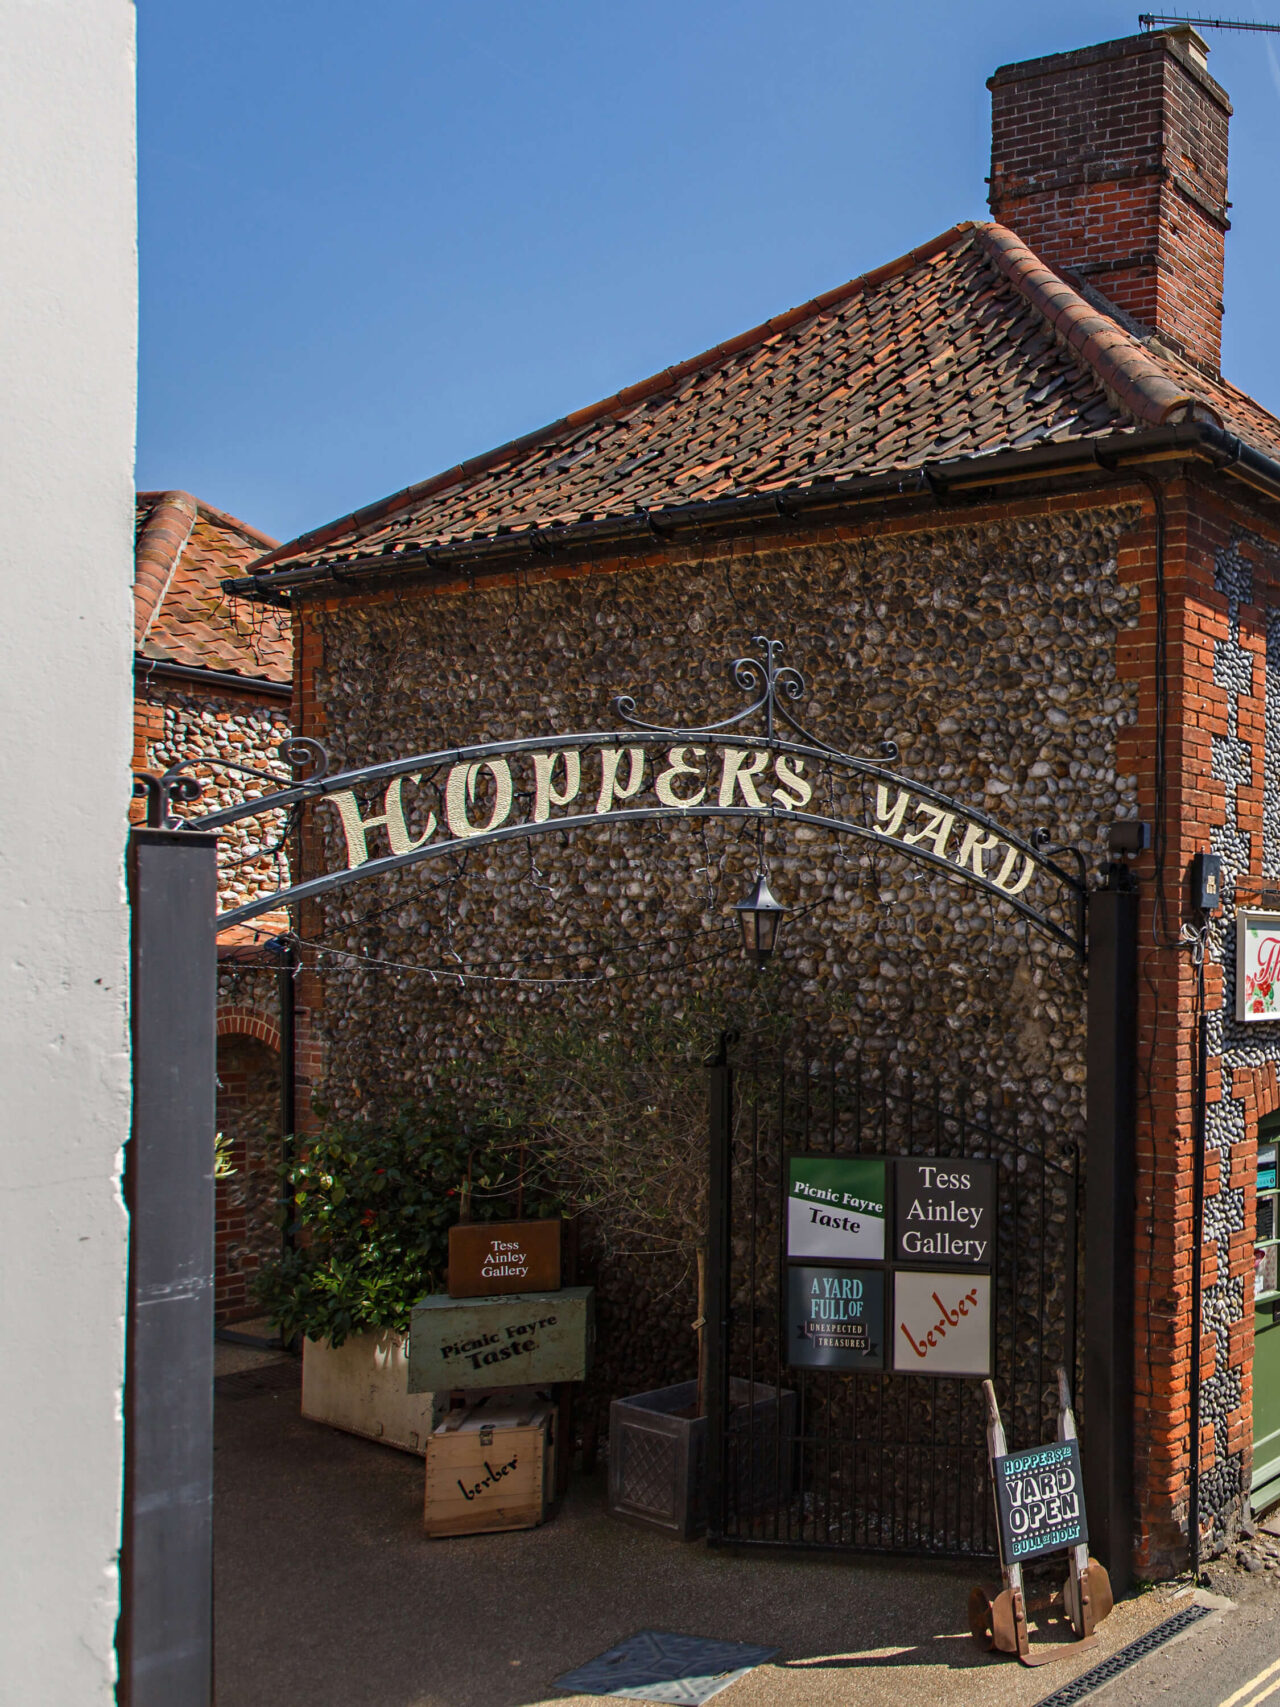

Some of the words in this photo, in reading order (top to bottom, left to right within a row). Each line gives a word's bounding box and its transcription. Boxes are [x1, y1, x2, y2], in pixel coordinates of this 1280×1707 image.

[320, 747, 813, 870] HOPPERS
[873, 782, 1036, 898] YARD
[918, 1166, 971, 1189] Tess
[793, 1181, 840, 1203] Picnic
[842, 1192, 884, 1213] Fayre
[809, 1207, 861, 1234] Taste
[906, 1199, 984, 1229] Ainley
[484, 1252, 527, 1264] Ainley
[490, 1240, 520, 1252] Tess
[902, 1231, 988, 1262] Gallery
[481, 1265, 529, 1278] Gallery
[810, 1277, 821, 1295] A
[823, 1277, 863, 1299] YARD
[811, 1298, 848, 1320] FULL
[848, 1300, 864, 1317] OF
[900, 1288, 978, 1358] berber
[440, 1333, 500, 1359] Picnic
[505, 1315, 558, 1339] Fayre
[810, 1323, 863, 1334] UNEXPECTED
[818, 1337, 866, 1348] TREASURES
[465, 1339, 536, 1370] Taste
[457, 1453, 520, 1501] berber
[1005, 1449, 1064, 1475] HOPPERS
[1006, 1467, 1076, 1507] YARD
[1009, 1492, 1080, 1534] OPEN
[1012, 1537, 1044, 1556] BULL
[1050, 1525, 1081, 1545] HOLT
